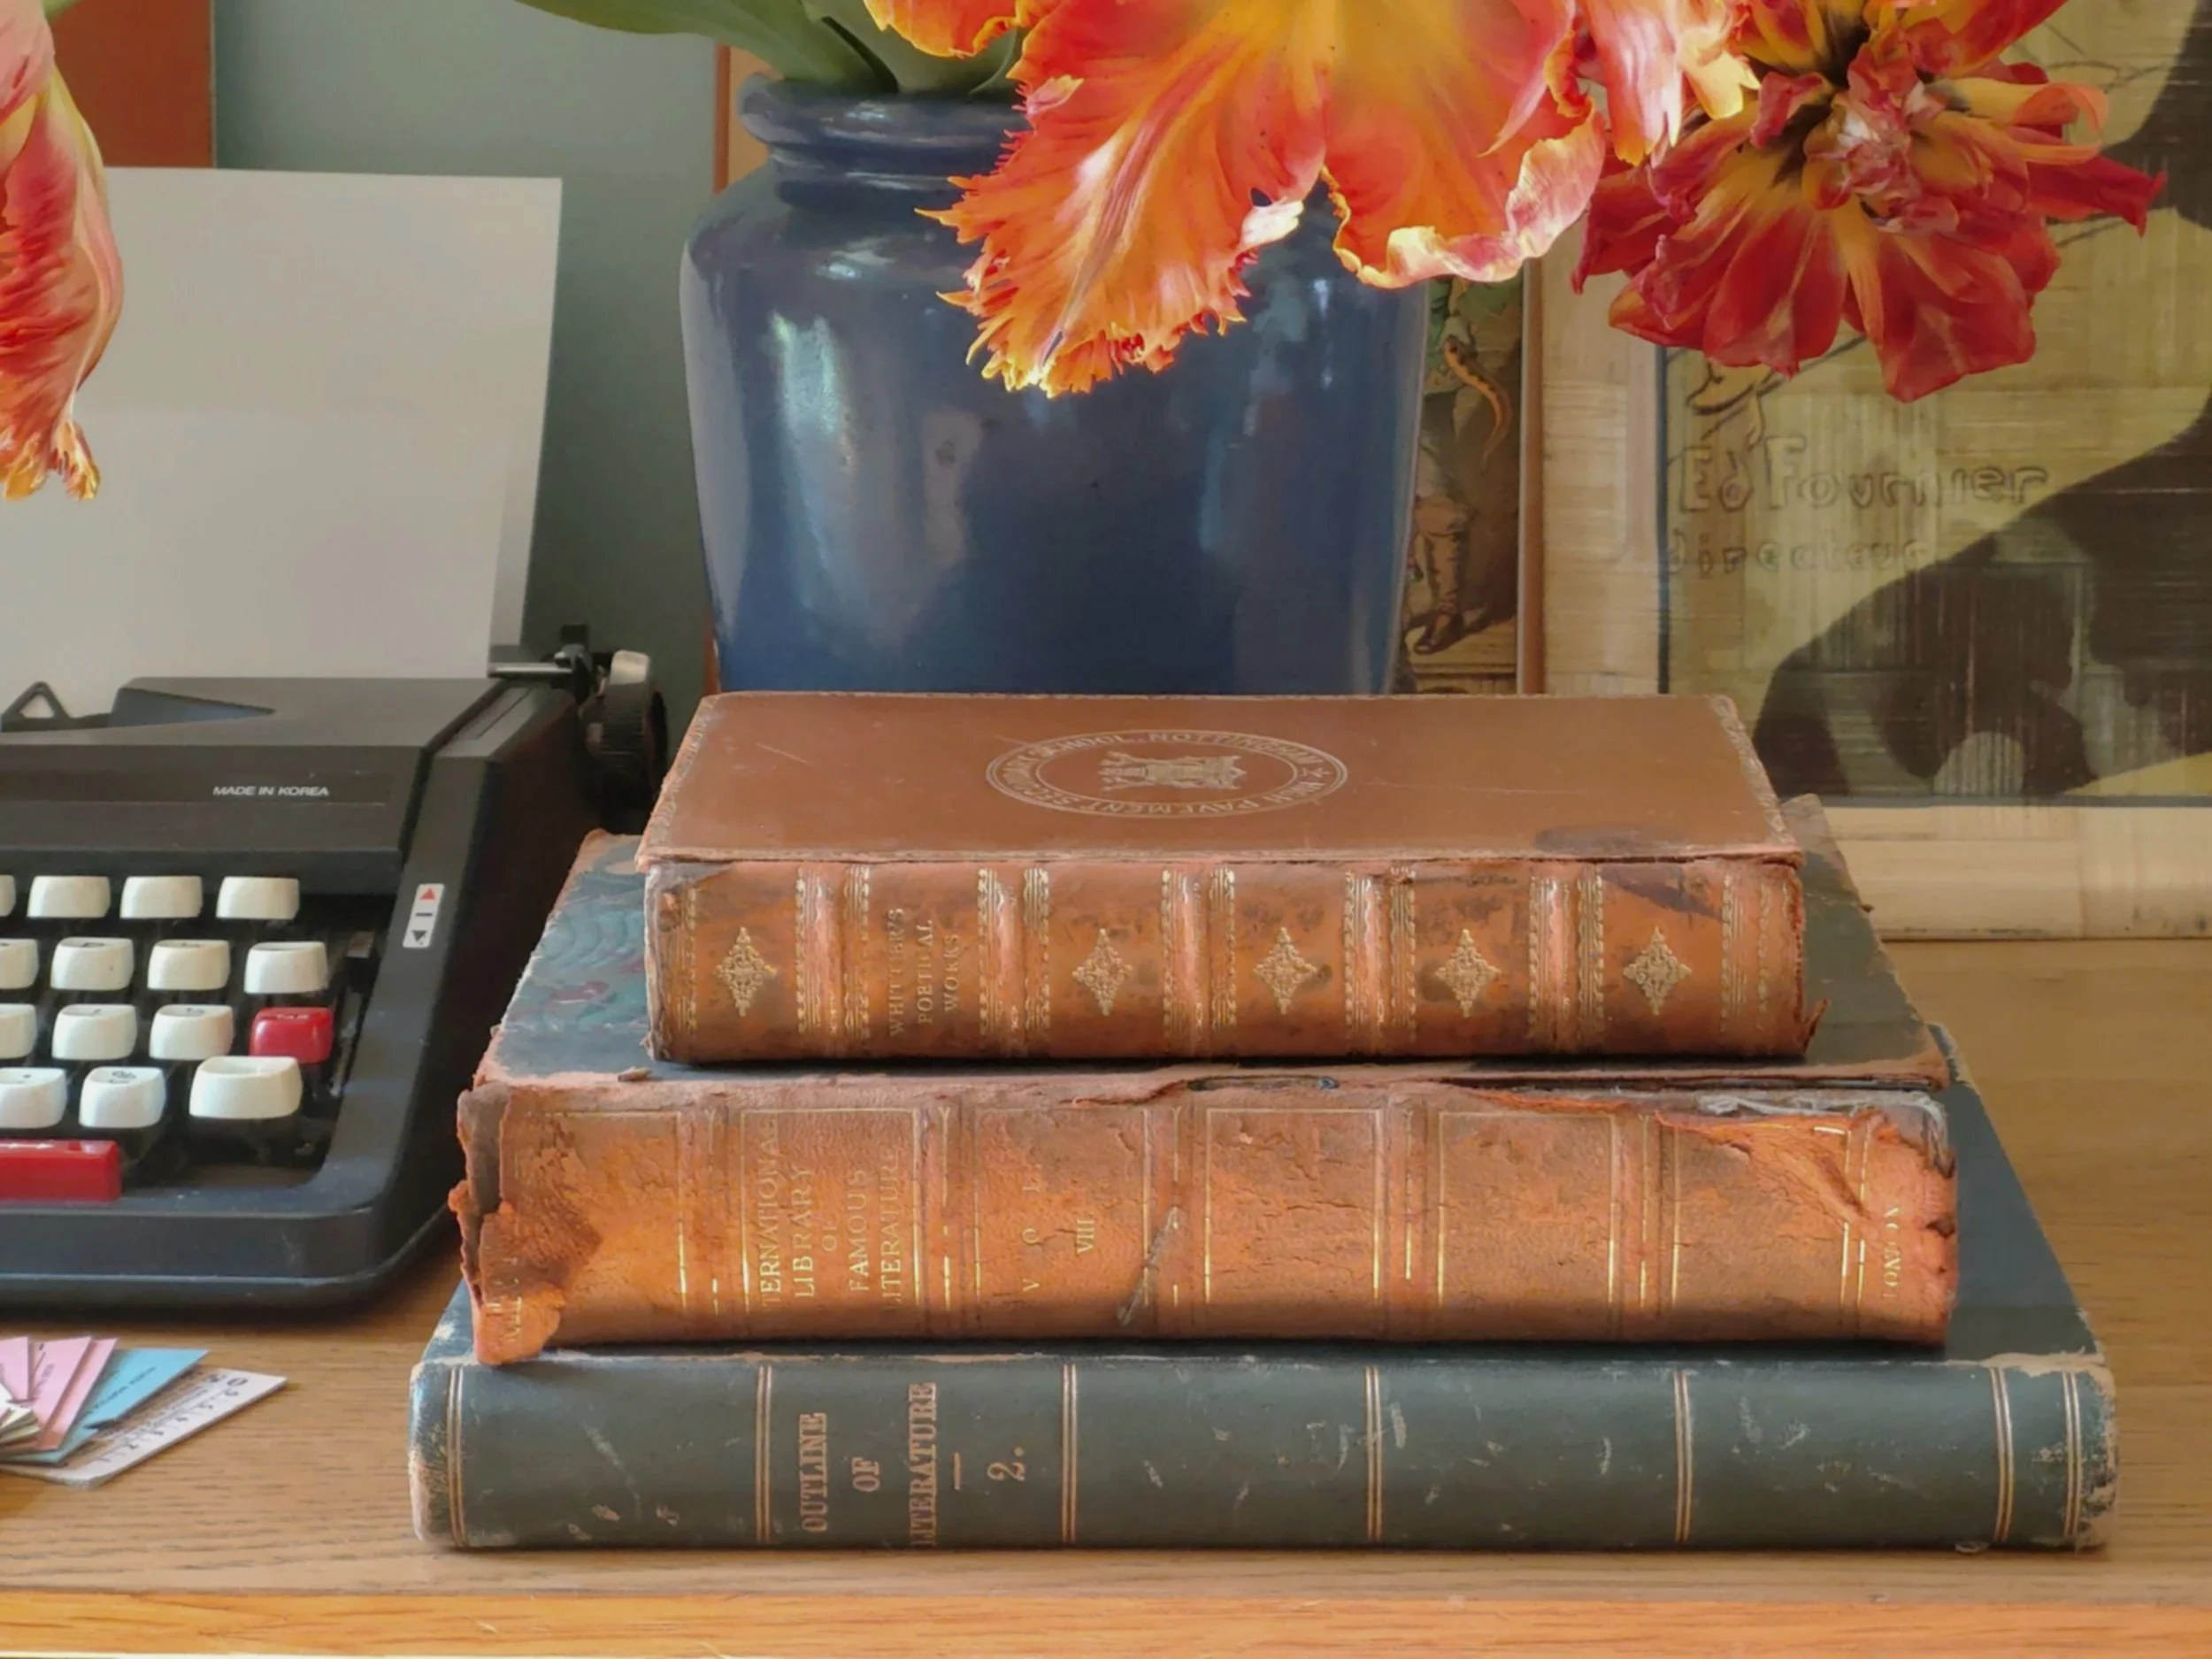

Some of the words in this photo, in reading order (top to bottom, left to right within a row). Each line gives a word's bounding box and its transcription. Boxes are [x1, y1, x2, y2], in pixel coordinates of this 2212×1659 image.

[1678, 445, 1755, 513] Ed
[1765, 434, 2049, 511] Fournier
[212, 785, 255, 796] MADE
[258, 785, 274, 796] IN
[278, 786, 329, 797] KOREA
[1263, 781, 1325, 804] HIGH
[916, 918, 934, 1025] POETICAL
[942, 933, 960, 1013] WORKS
[790, 1162, 815, 1299] LIBRARY
[846, 1170, 870, 1292] FAMOUS
[798, 1411, 828, 1533] OUTLINE
[850, 1456, 882, 1494] OF
[908, 1381, 938, 1548] LITERATURE
[987, 1445, 1025, 1482] 2.
